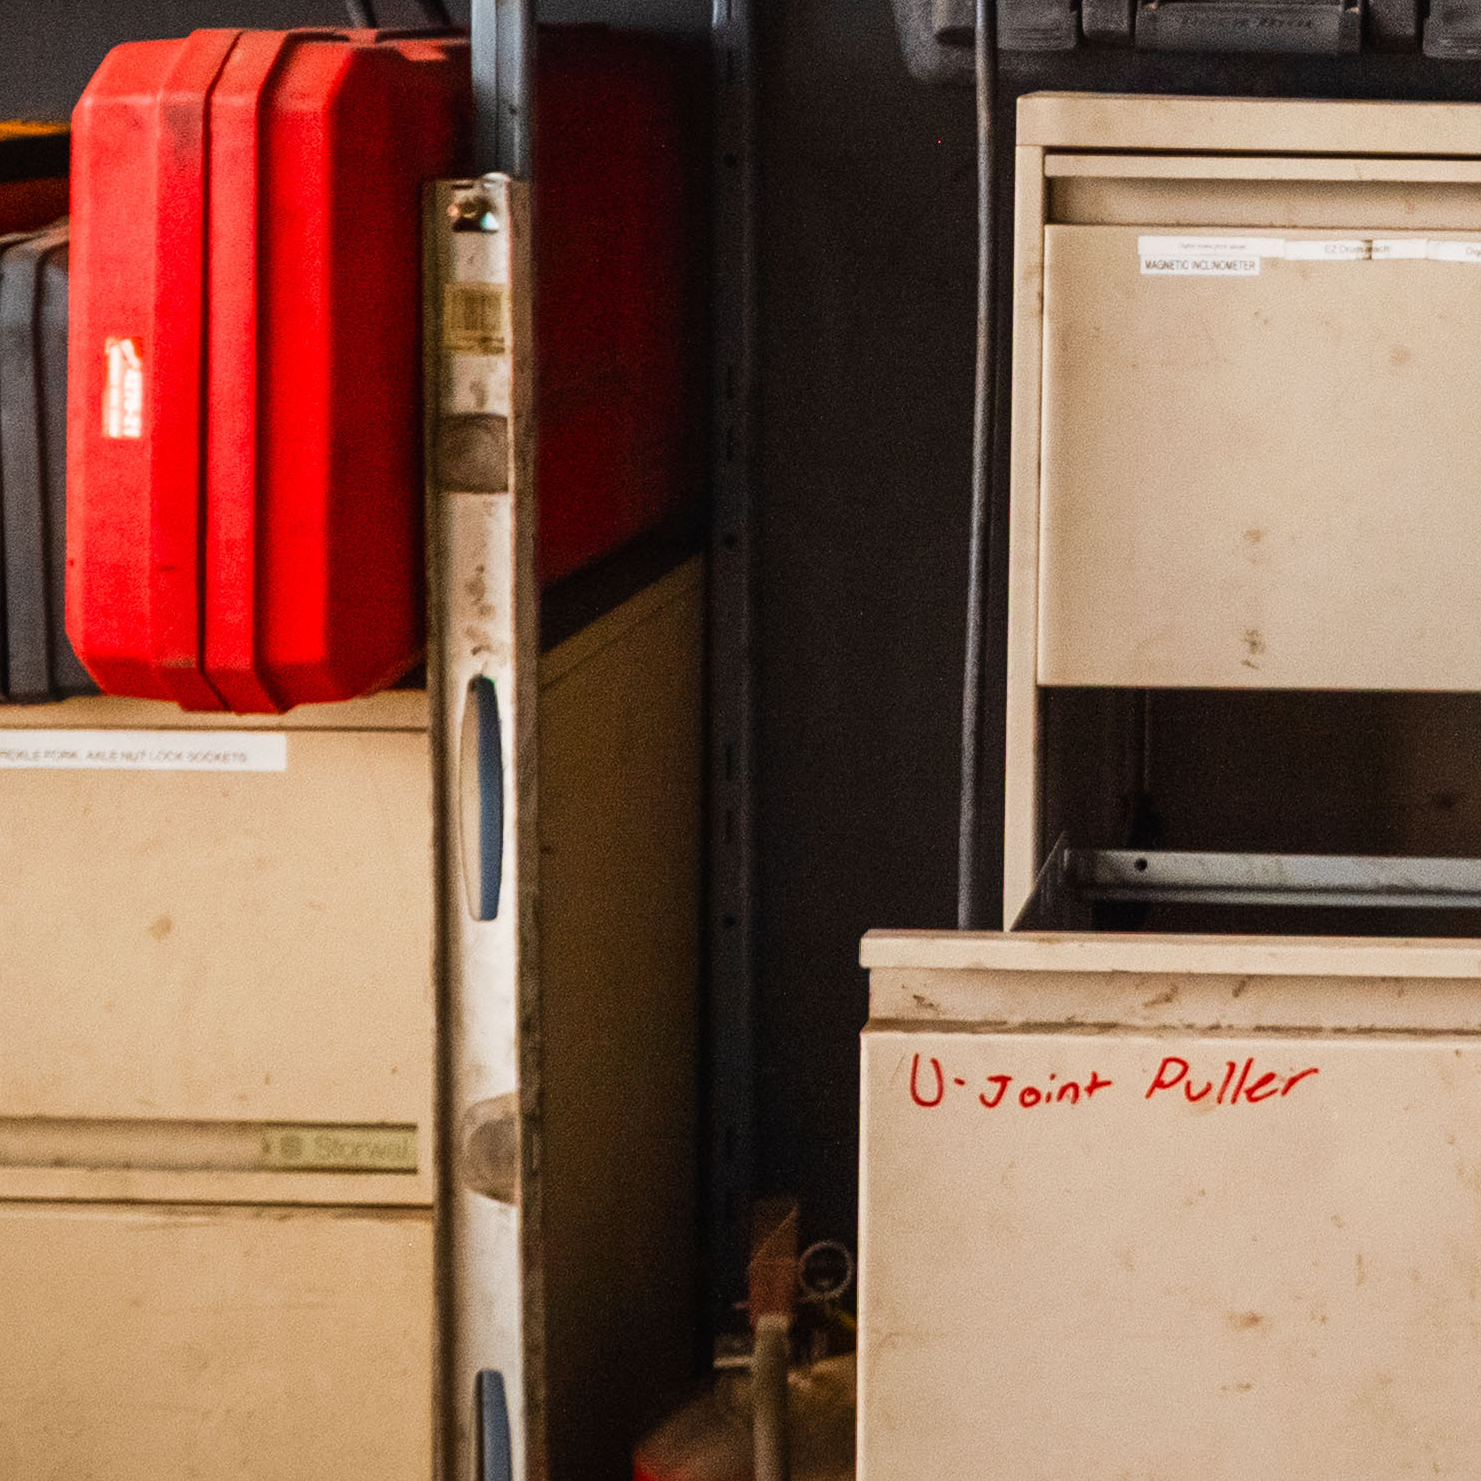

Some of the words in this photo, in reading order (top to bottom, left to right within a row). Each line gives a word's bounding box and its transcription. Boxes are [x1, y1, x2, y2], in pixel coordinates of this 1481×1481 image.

[1145, 259, 1189, 272] MAGNETIC
[1191, 259, 1256, 272] INCLINOMETER
[910, 1053, 1112, 1108] U-Joint
[1145, 1056, 1319, 1105] Puller
